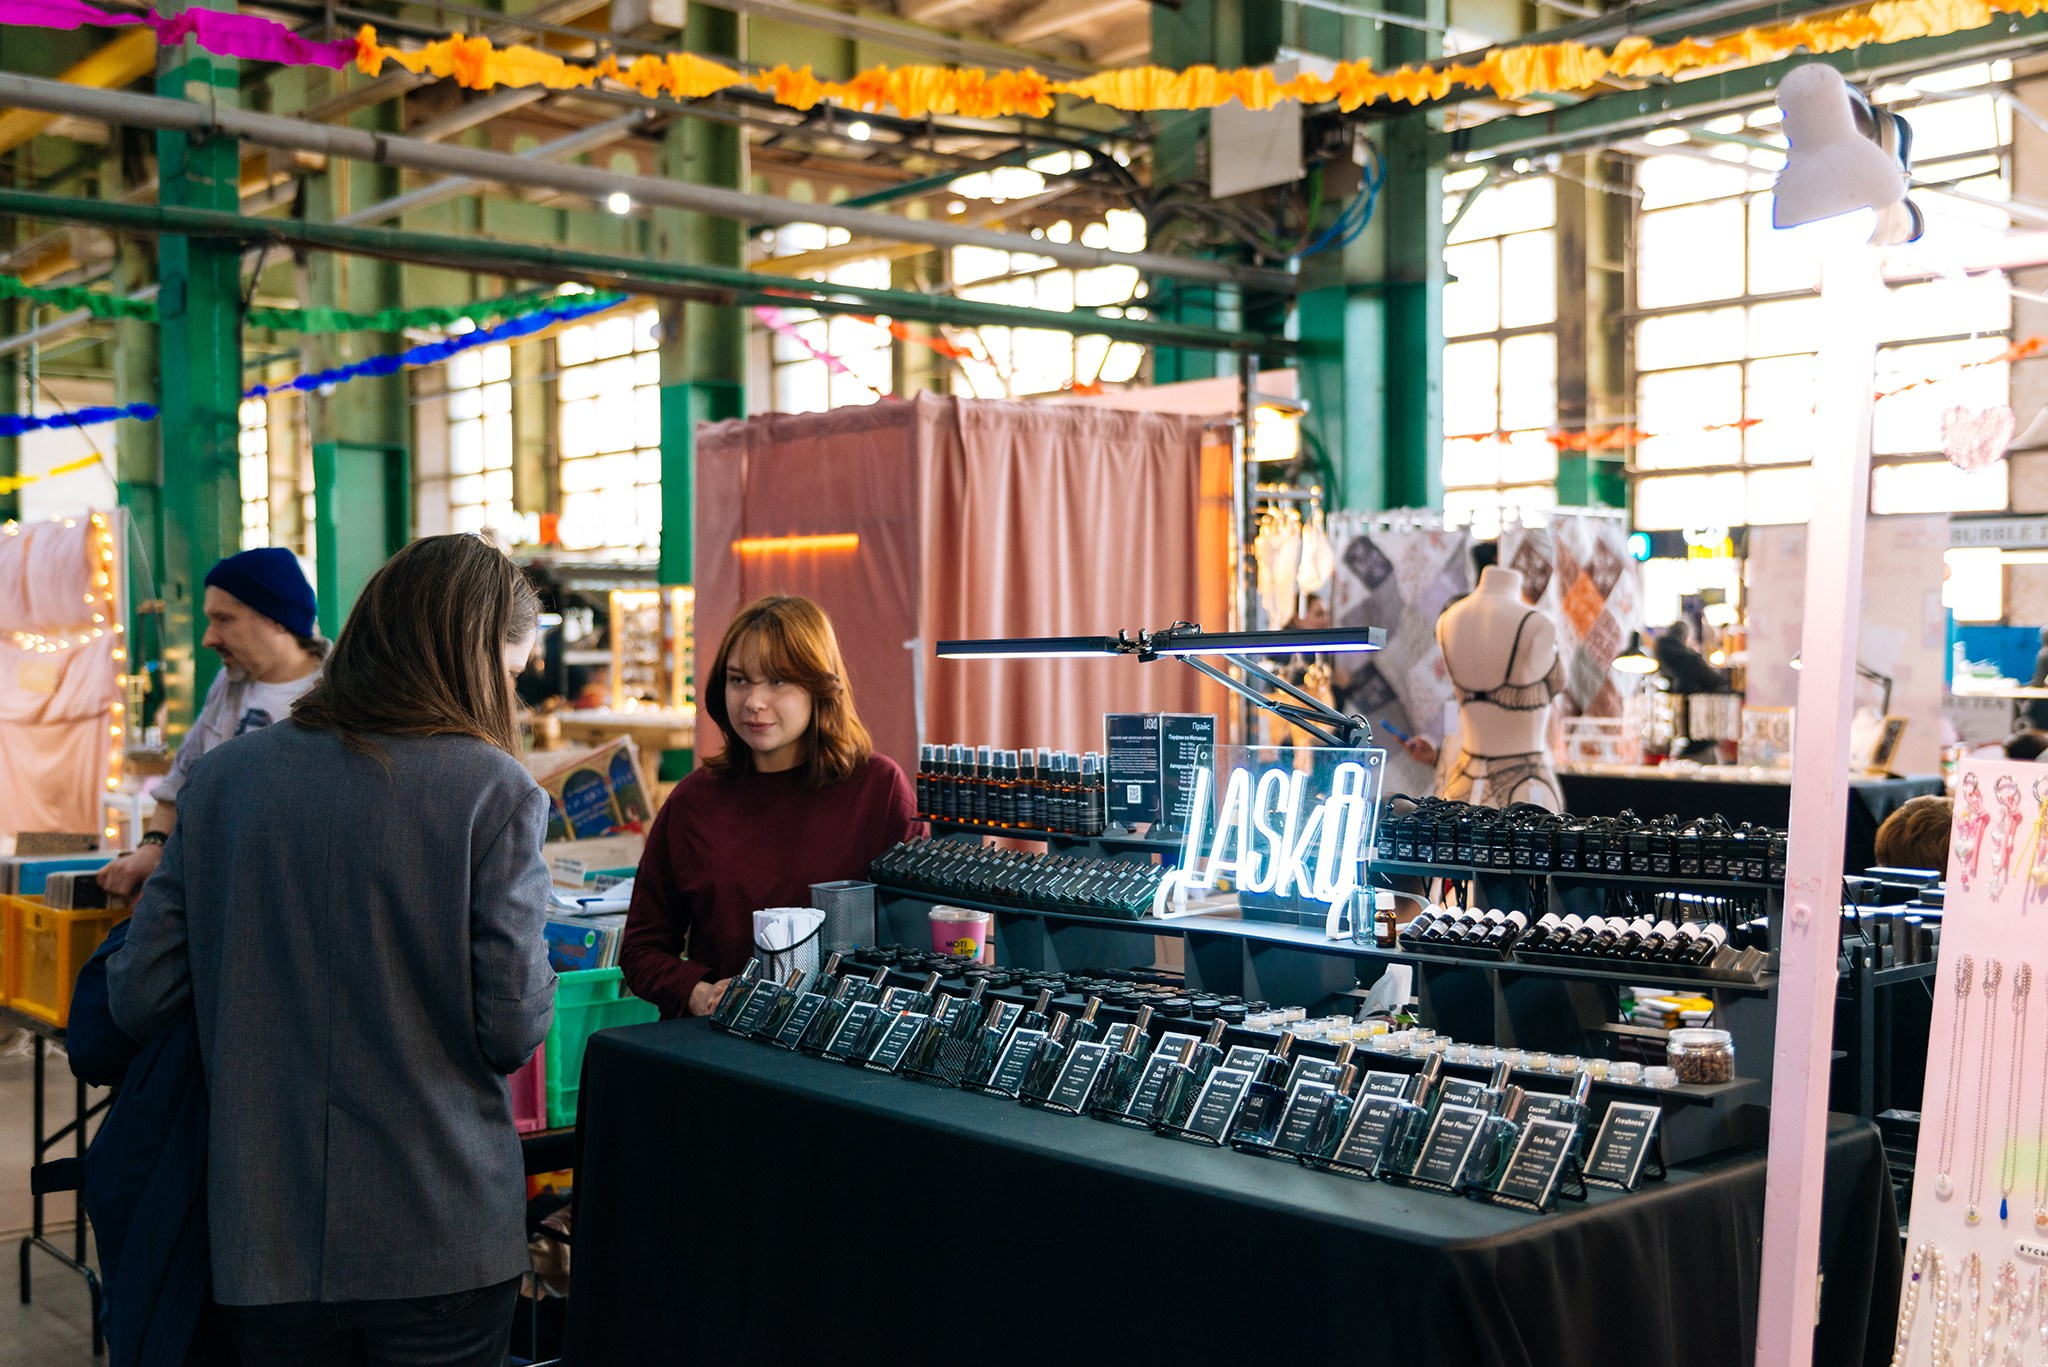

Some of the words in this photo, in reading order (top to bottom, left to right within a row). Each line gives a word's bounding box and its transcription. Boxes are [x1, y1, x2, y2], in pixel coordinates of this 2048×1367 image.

[1951, 526, 2032, 545] BUBBLE
[1192, 722, 1211, 732] Прайс
[1243, 1059, 1256, 1067] Spirit
[1302, 1070, 1320, 1079] Passion
[1222, 1080, 1241, 1089] Bouquet
[1370, 1083, 1381, 1091] Tart
[1444, 1092, 1462, 1101] Dragon
[1462, 1095, 1473, 1104] Lily
[1369, 1109, 1380, 1117] Mint
[1380, 1110, 1390, 1118] Tea
[1528, 1105, 1551, 1115] Coconut
[1441, 1118, 1454, 1127] Sour
[1454, 1120, 1474, 1131] Flower
[1614, 1116, 1645, 1127] Freshness
[1533, 1136, 1544, 1144] Sea
[1544, 1137, 1557, 1146] Tree
